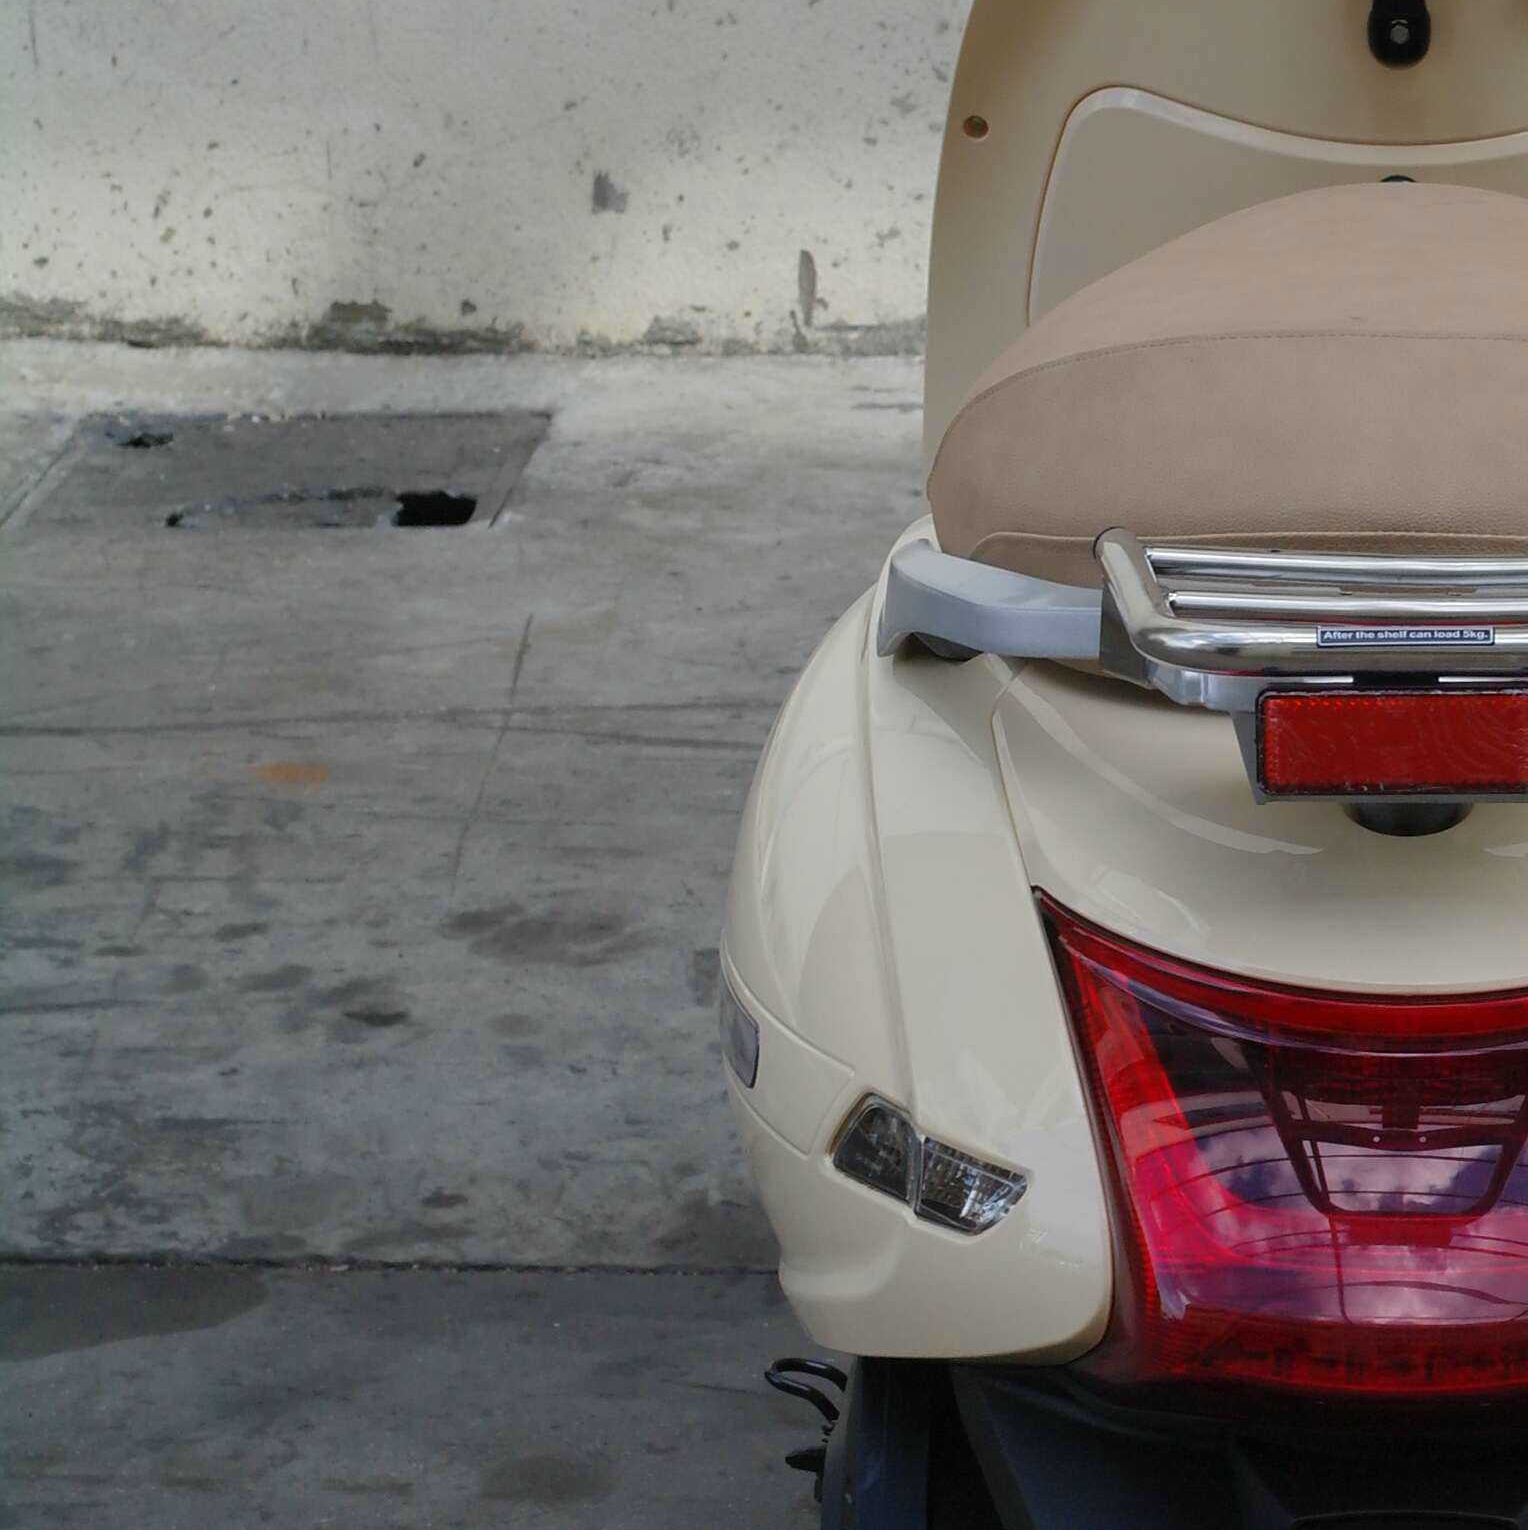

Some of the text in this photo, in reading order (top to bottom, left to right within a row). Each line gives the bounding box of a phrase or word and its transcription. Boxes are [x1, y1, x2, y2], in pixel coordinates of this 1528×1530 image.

[1324, 631, 1354, 639] After
[1356, 631, 1375, 639] the
[1377, 631, 1407, 639] shelf
[1434, 630, 1460, 638] load
[1463, 630, 1488, 640] 5kg.
